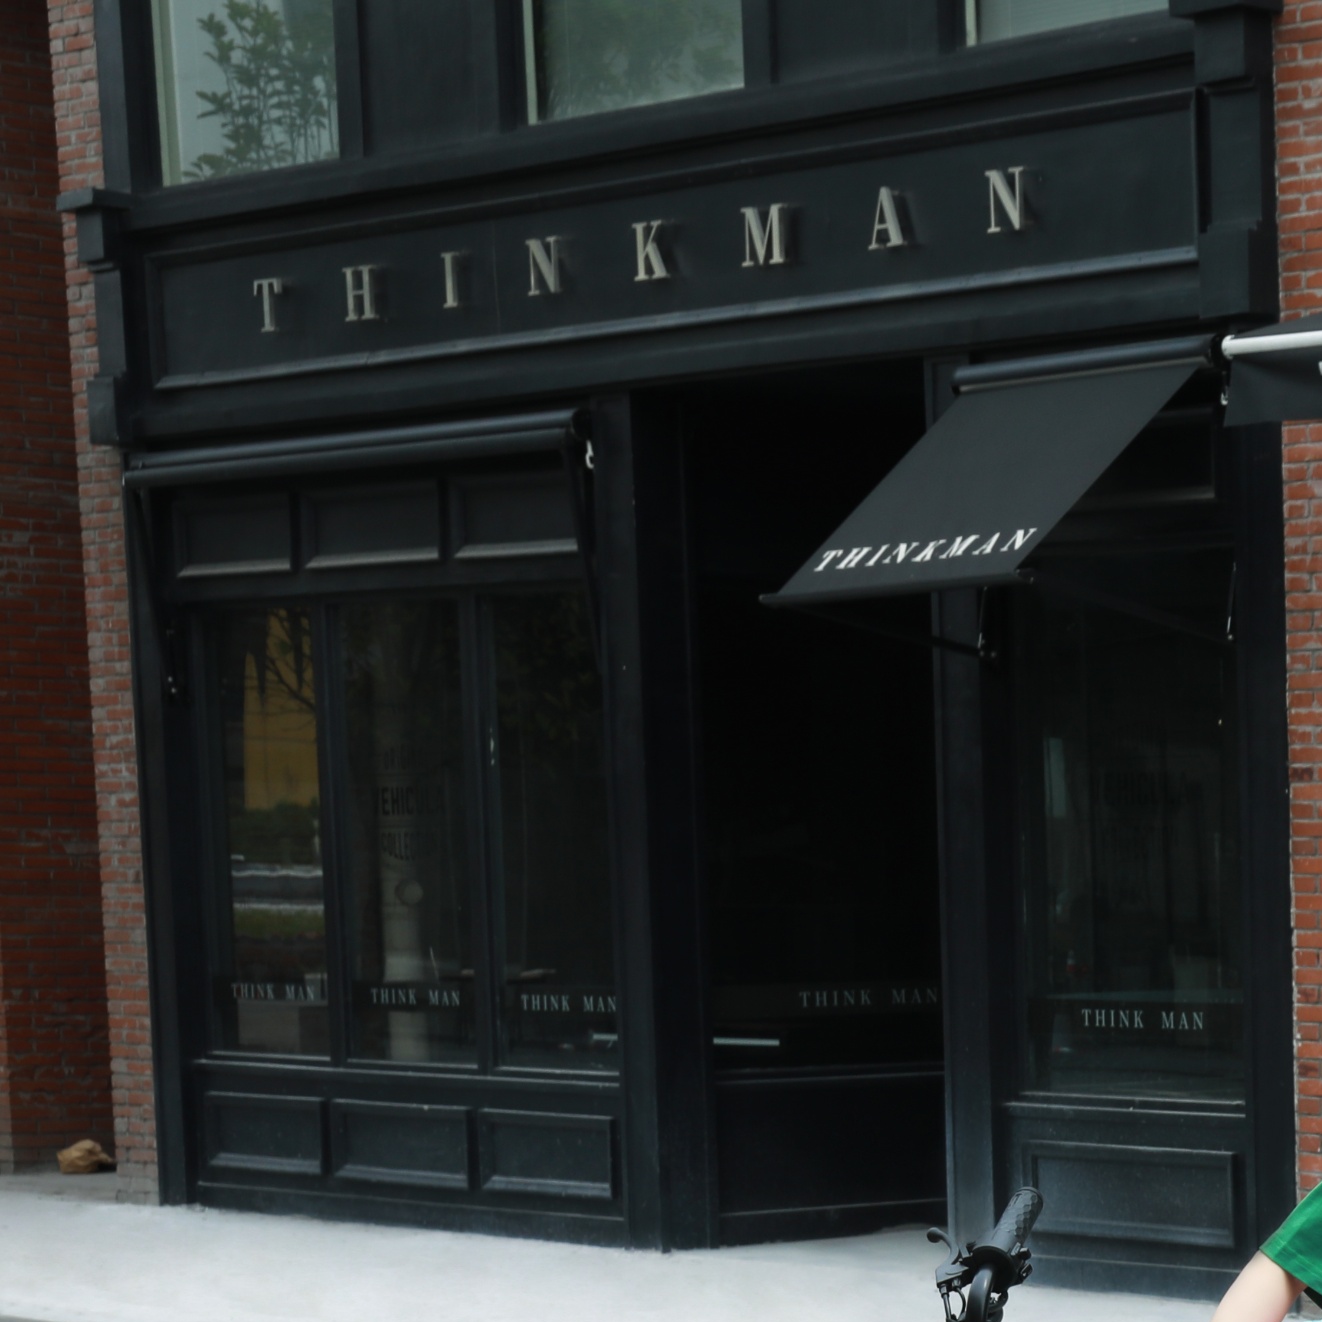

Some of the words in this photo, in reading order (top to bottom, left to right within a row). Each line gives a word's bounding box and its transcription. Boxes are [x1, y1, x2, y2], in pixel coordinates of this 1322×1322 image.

[815, 528, 1038, 572] THINKMAN
[231, 983, 275, 1000] THINK
[285, 984, 315, 1000] MAN
[371, 987, 417, 1005] THINK
[429, 989, 461, 1007] MAN
[799, 988, 872, 1008] THINK
[891, 987, 938, 1005] MAN
[521, 994, 570, 1012] THINK
[584, 995, 617, 1013] MAN
[1081, 1008, 1144, 1029] THINK
[1161, 1010, 1204, 1030] MAN
